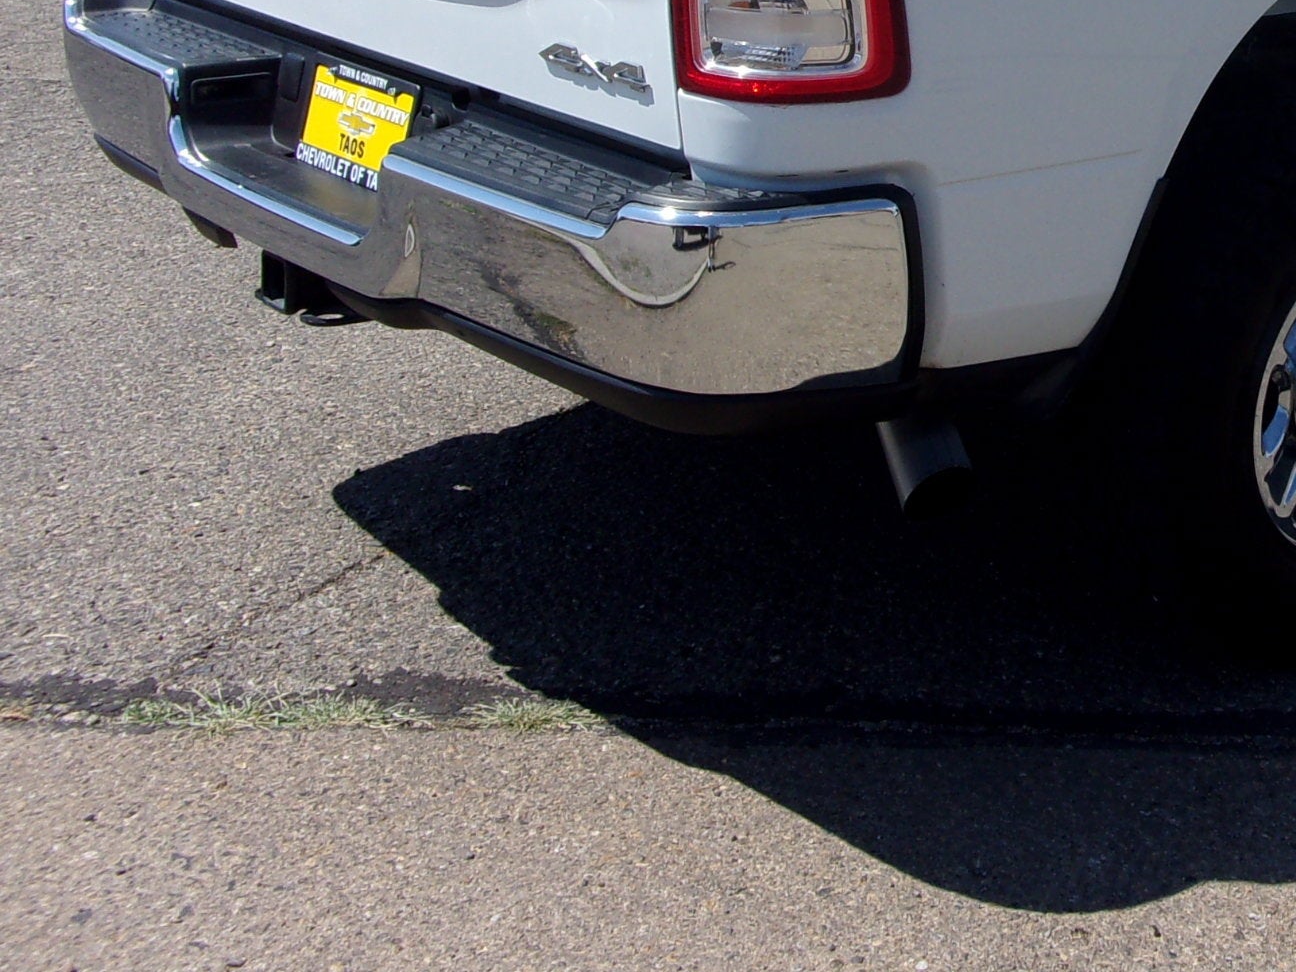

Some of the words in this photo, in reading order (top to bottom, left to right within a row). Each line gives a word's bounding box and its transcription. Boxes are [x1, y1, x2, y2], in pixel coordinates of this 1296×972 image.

[338, 64, 356, 79] TOWN
[361, 72, 388, 90] COUNTRY
[315, 83, 346, 104] TOWN
[346, 94, 357, 108] &
[357, 97, 409, 126] COUNTRY
[339, 133, 366, 159] TAOS
[296, 143, 351, 179] CHEVROLET
[350, 165, 365, 184] OF
